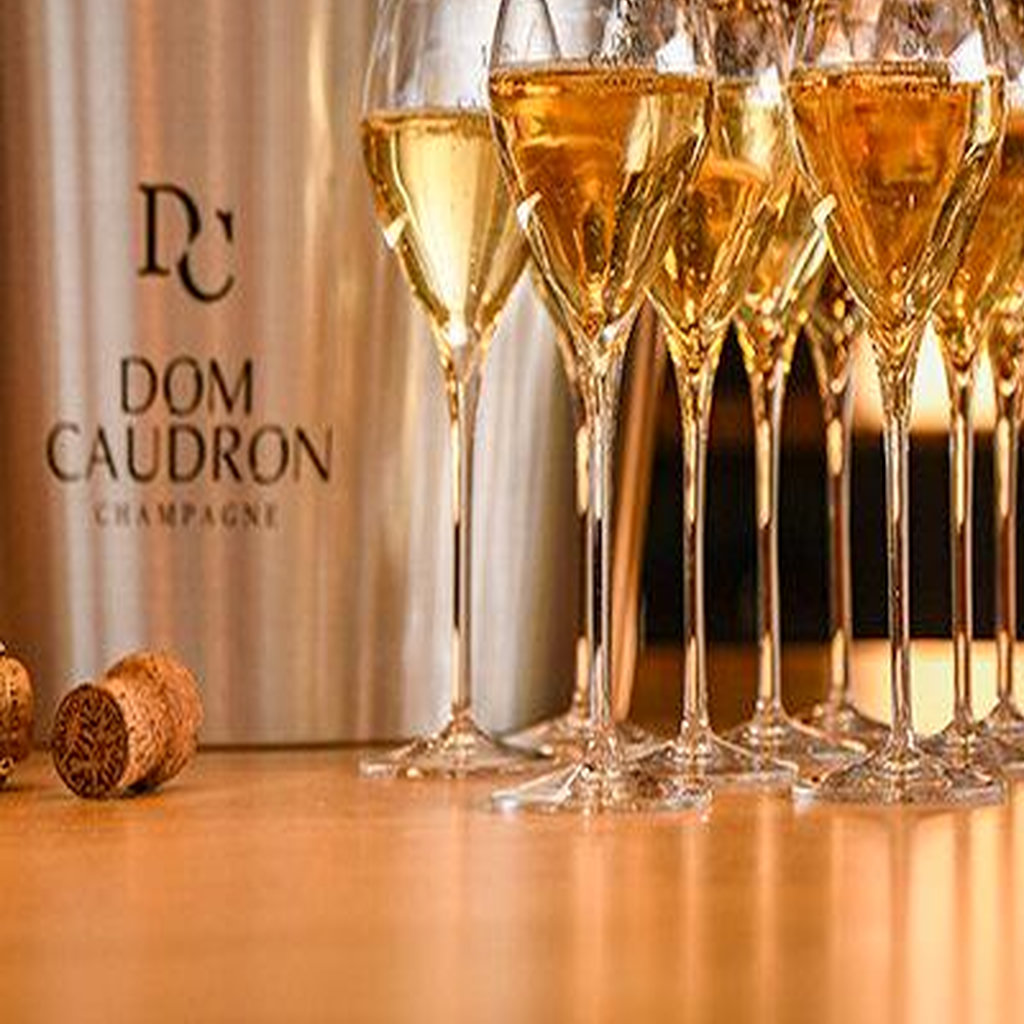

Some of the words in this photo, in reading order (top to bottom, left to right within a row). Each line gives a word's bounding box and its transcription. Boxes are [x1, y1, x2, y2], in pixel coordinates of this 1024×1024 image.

[120, 355, 253, 416] DOM
[46, 423, 333, 484] CAUDRON
[95, 501, 279, 529] CHAMPAGNE
